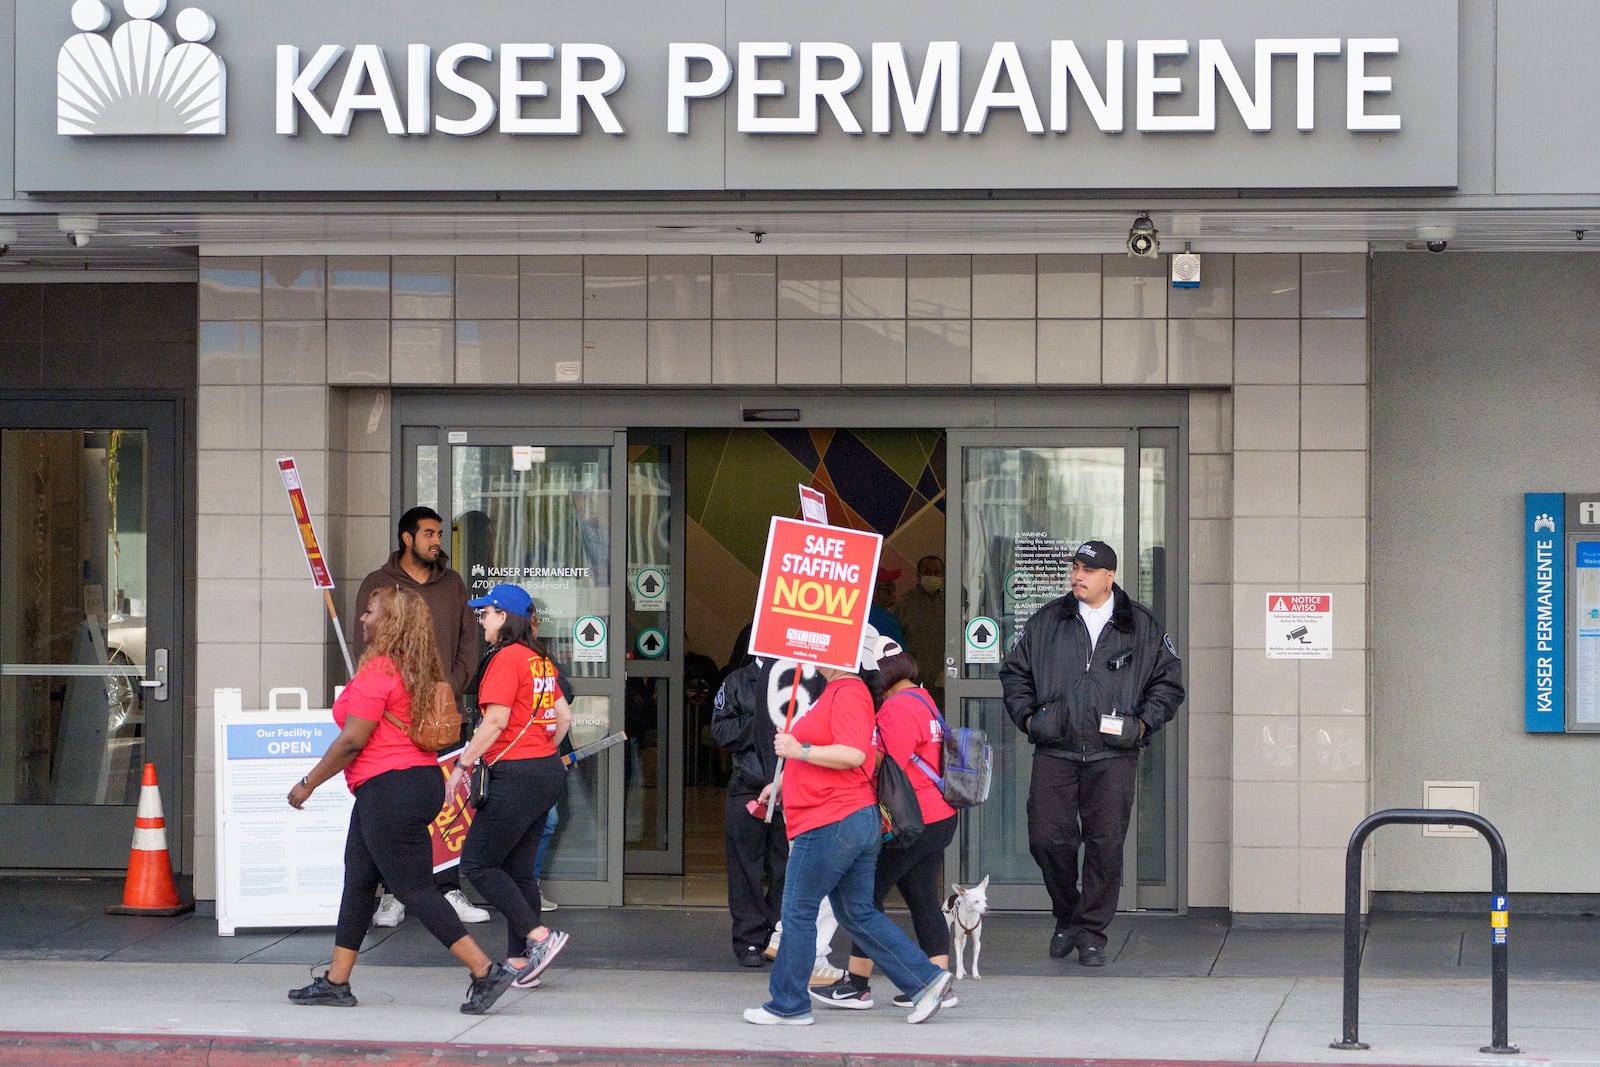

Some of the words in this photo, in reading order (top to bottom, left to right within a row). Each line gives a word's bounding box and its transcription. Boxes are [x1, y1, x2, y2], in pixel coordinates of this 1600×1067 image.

[275, 42, 626, 136] KAISER
[667, 38, 1402, 135] PERMANENTE
[803, 534, 846, 559] SAFE
[487, 567, 521, 577] KAISER
[523, 567, 590, 577] PERMANENTE
[781, 553, 860, 583] STAFFING
[472, 580, 495, 589] 4700
[527, 580, 569, 589] Boulevard
[773, 576, 860, 617] NOW
[1291, 596, 1321, 604] NOTICE
[1536, 539, 1553, 651] PERMANENTE
[1291, 604, 1316, 612] AVISO
[1536, 657, 1553, 712] KAISER
[256, 728, 276, 738] Our
[277, 727, 312, 740] Facility
[314, 727, 323, 737] is
[267, 741, 312, 754] OPEN
